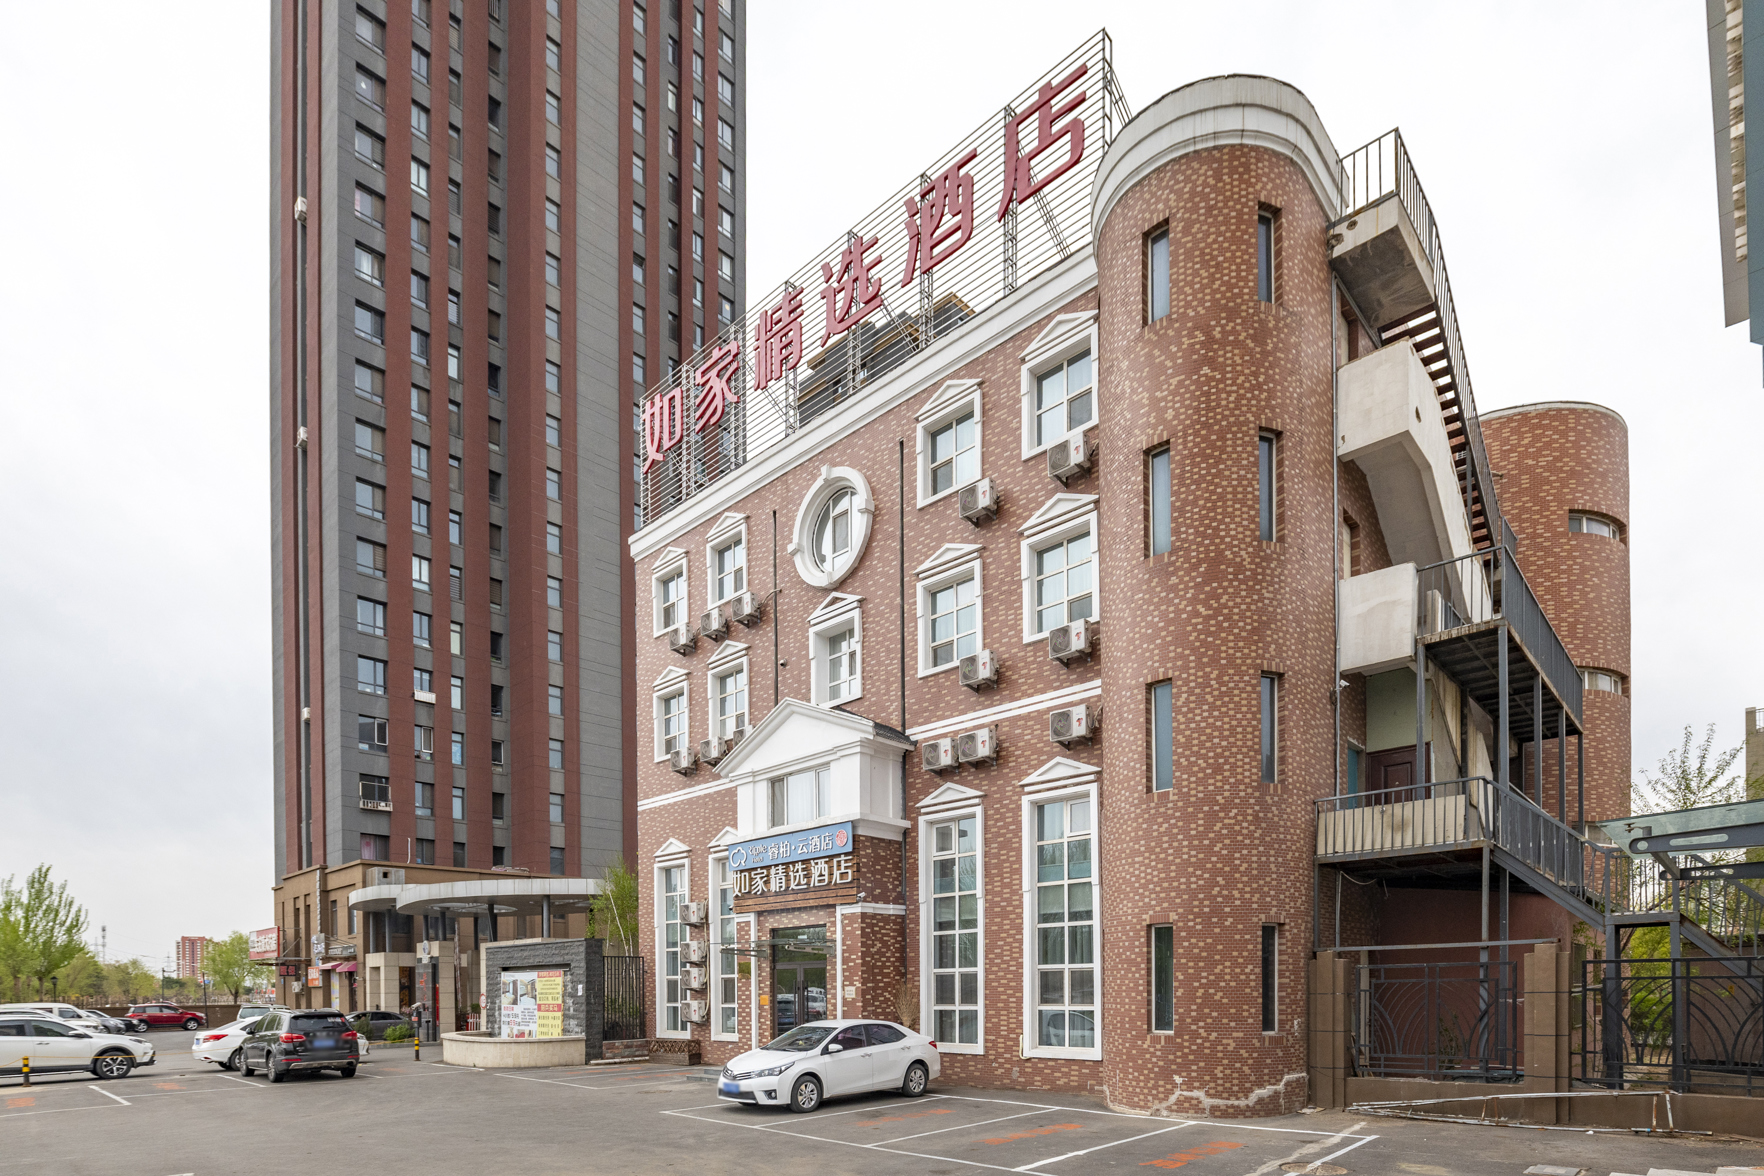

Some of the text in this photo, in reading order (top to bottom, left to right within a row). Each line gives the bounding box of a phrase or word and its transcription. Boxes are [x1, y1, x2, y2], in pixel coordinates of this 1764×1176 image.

[641, 63, 1088, 474] 如家精选酒店
[768, 832, 833, 860] 睿柏·云酒店
[733, 855, 853, 897] 如家精选酒店
